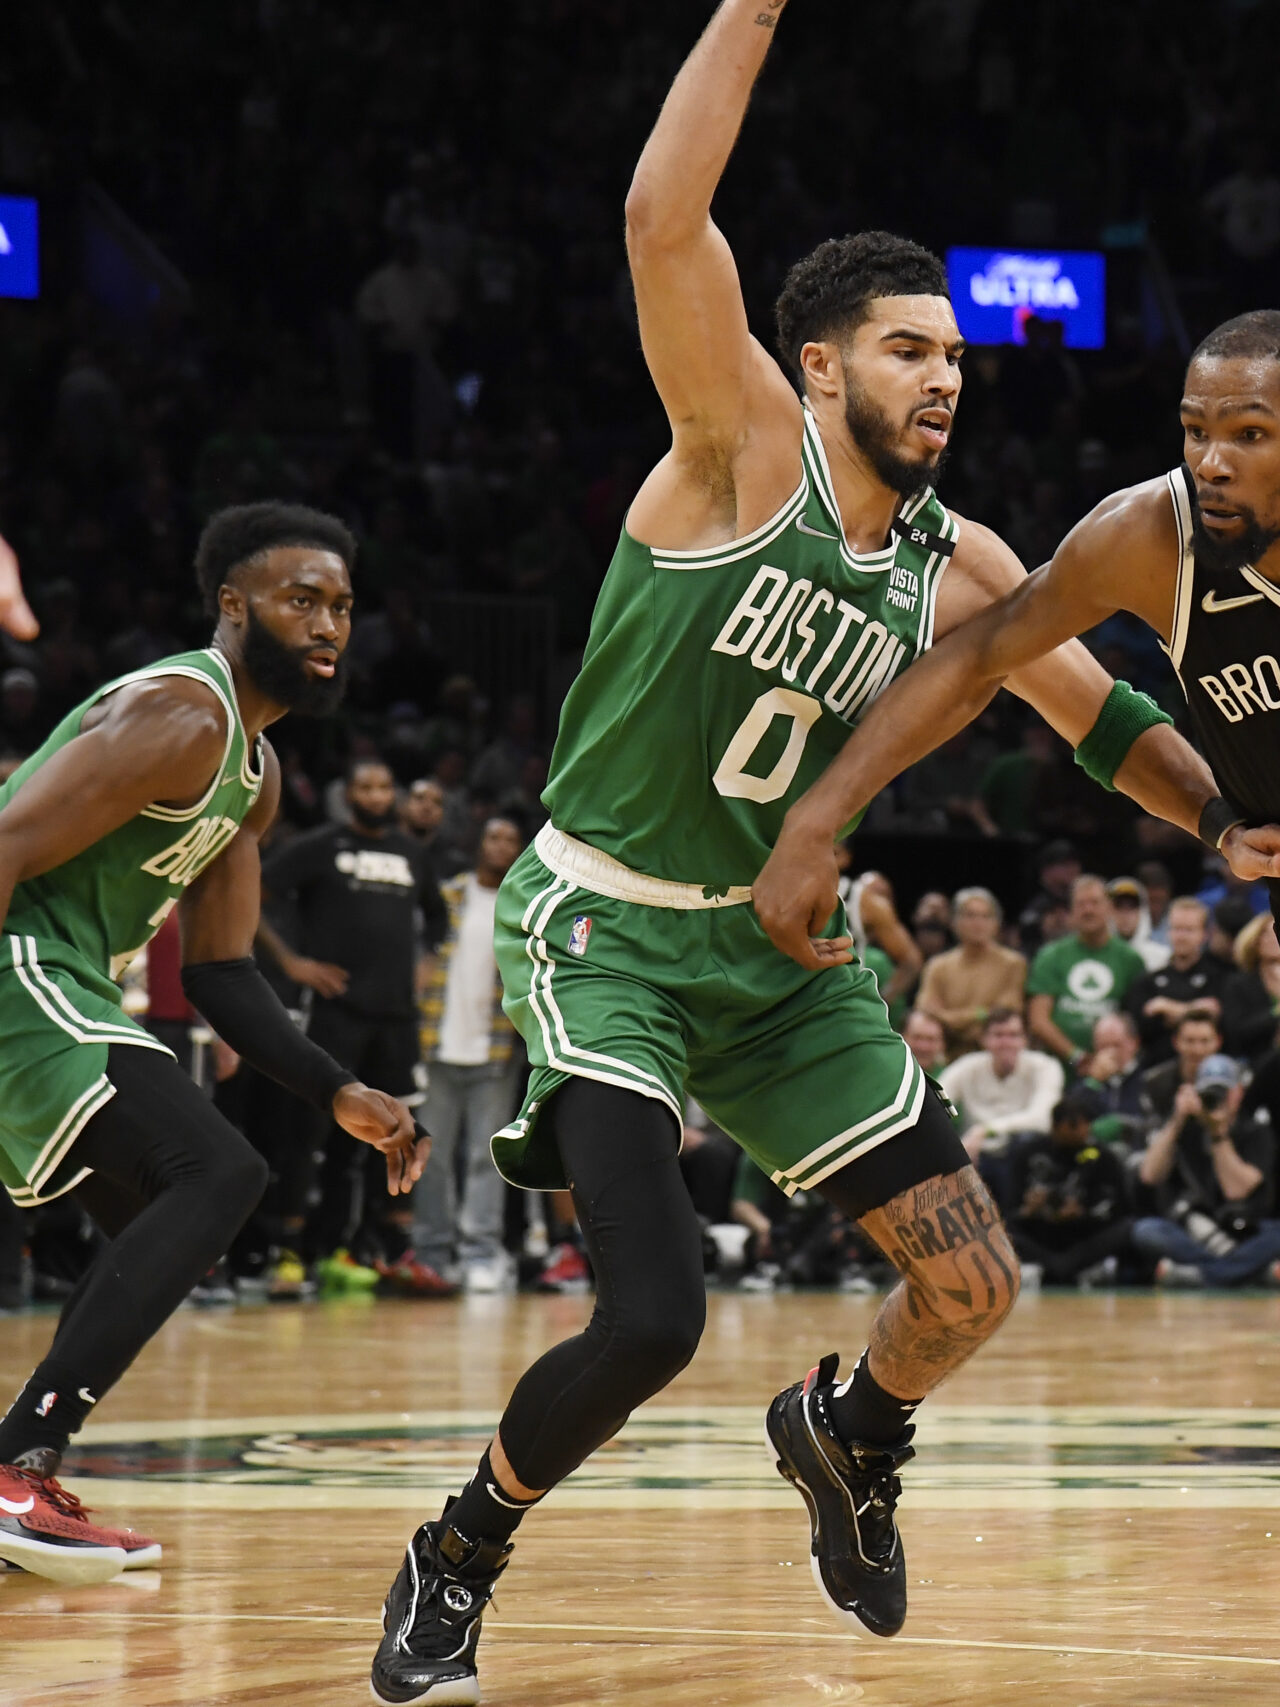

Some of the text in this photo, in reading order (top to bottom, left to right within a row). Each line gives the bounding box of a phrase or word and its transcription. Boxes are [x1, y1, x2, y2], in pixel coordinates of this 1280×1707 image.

[970, 272, 1080, 310] ULTRA
[910, 528, 928, 545] 24
[886, 587, 918, 613] PRINT
[889, 566, 919, 597] VISTA
[711, 564, 907, 721] BOSTON
[712, 686, 823, 804] 0
[894, 1191, 996, 1260] GRATE
